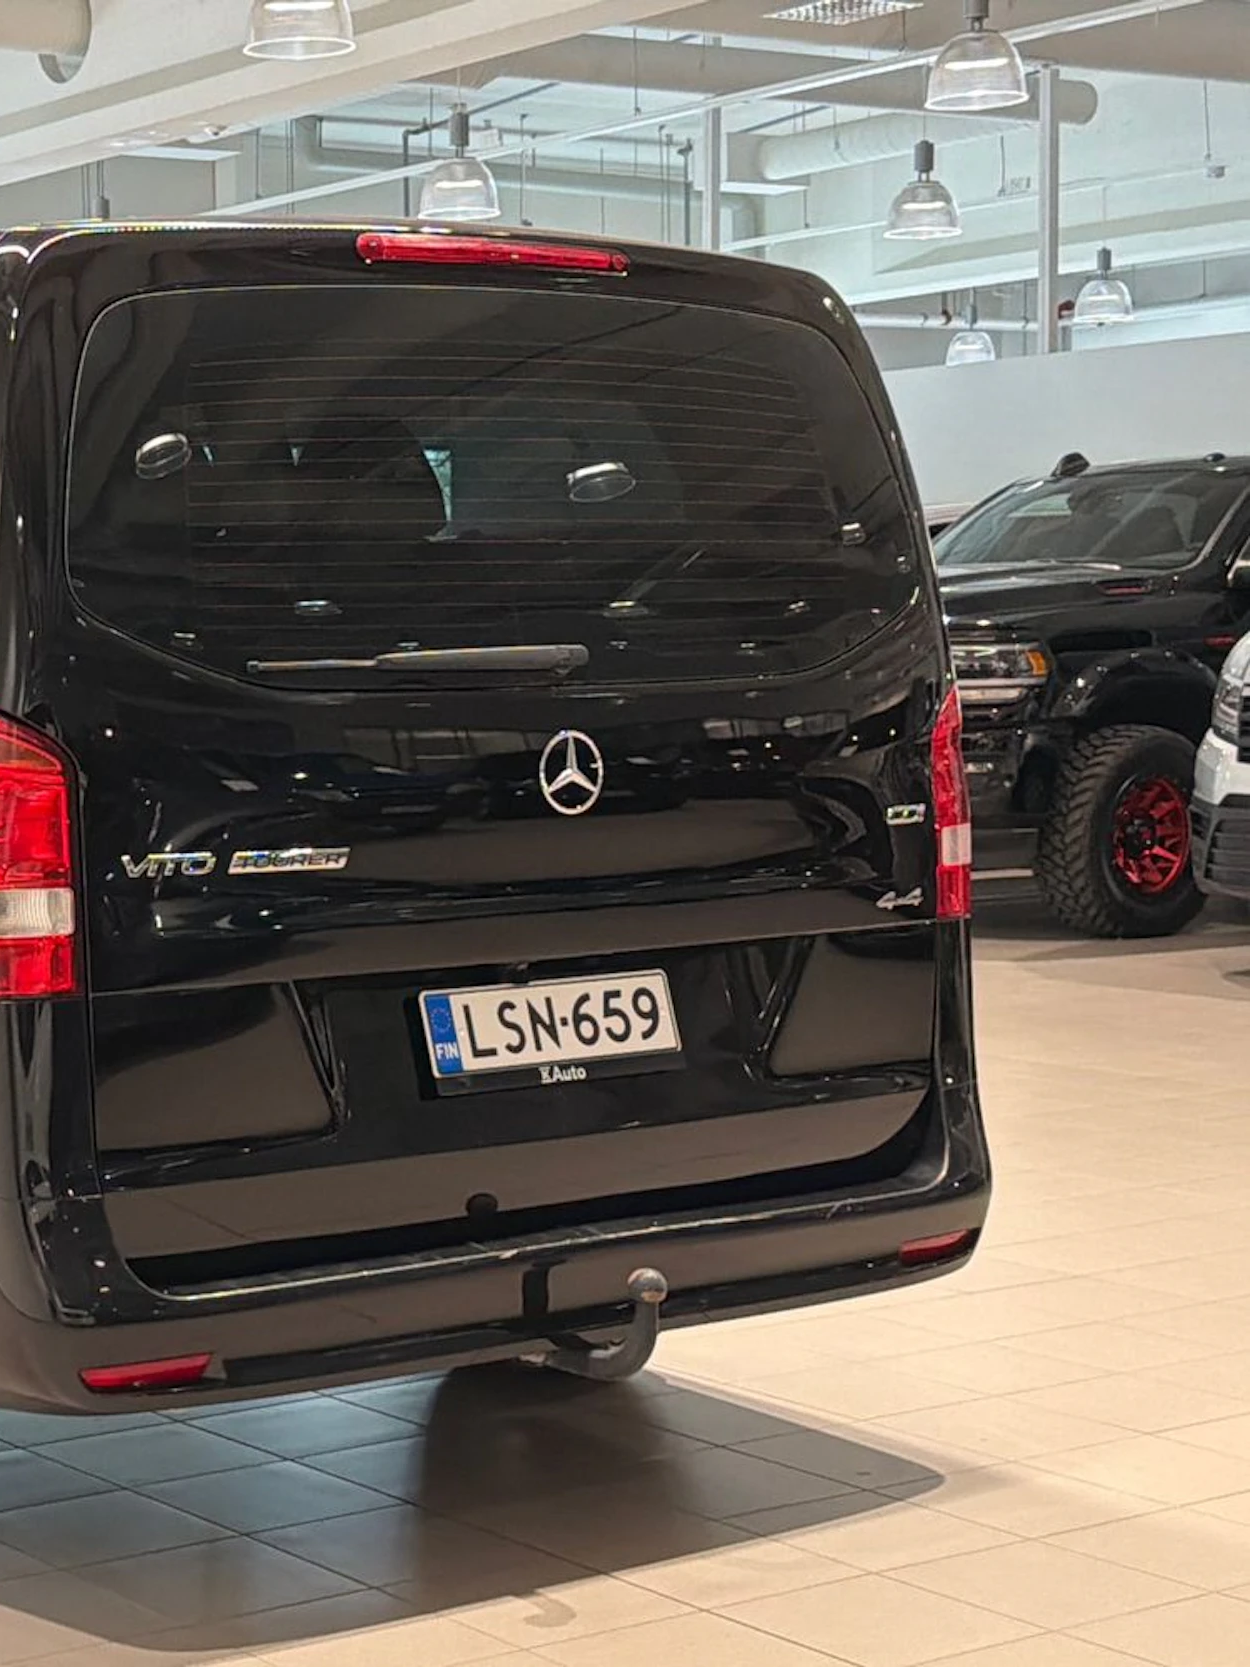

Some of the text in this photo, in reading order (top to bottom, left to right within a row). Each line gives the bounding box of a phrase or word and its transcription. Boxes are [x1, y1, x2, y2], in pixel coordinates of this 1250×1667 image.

[120, 850, 217, 879] VITO
[462, 986, 660, 1058] LSN-659
[435, 1041, 459, 1060] FIN
